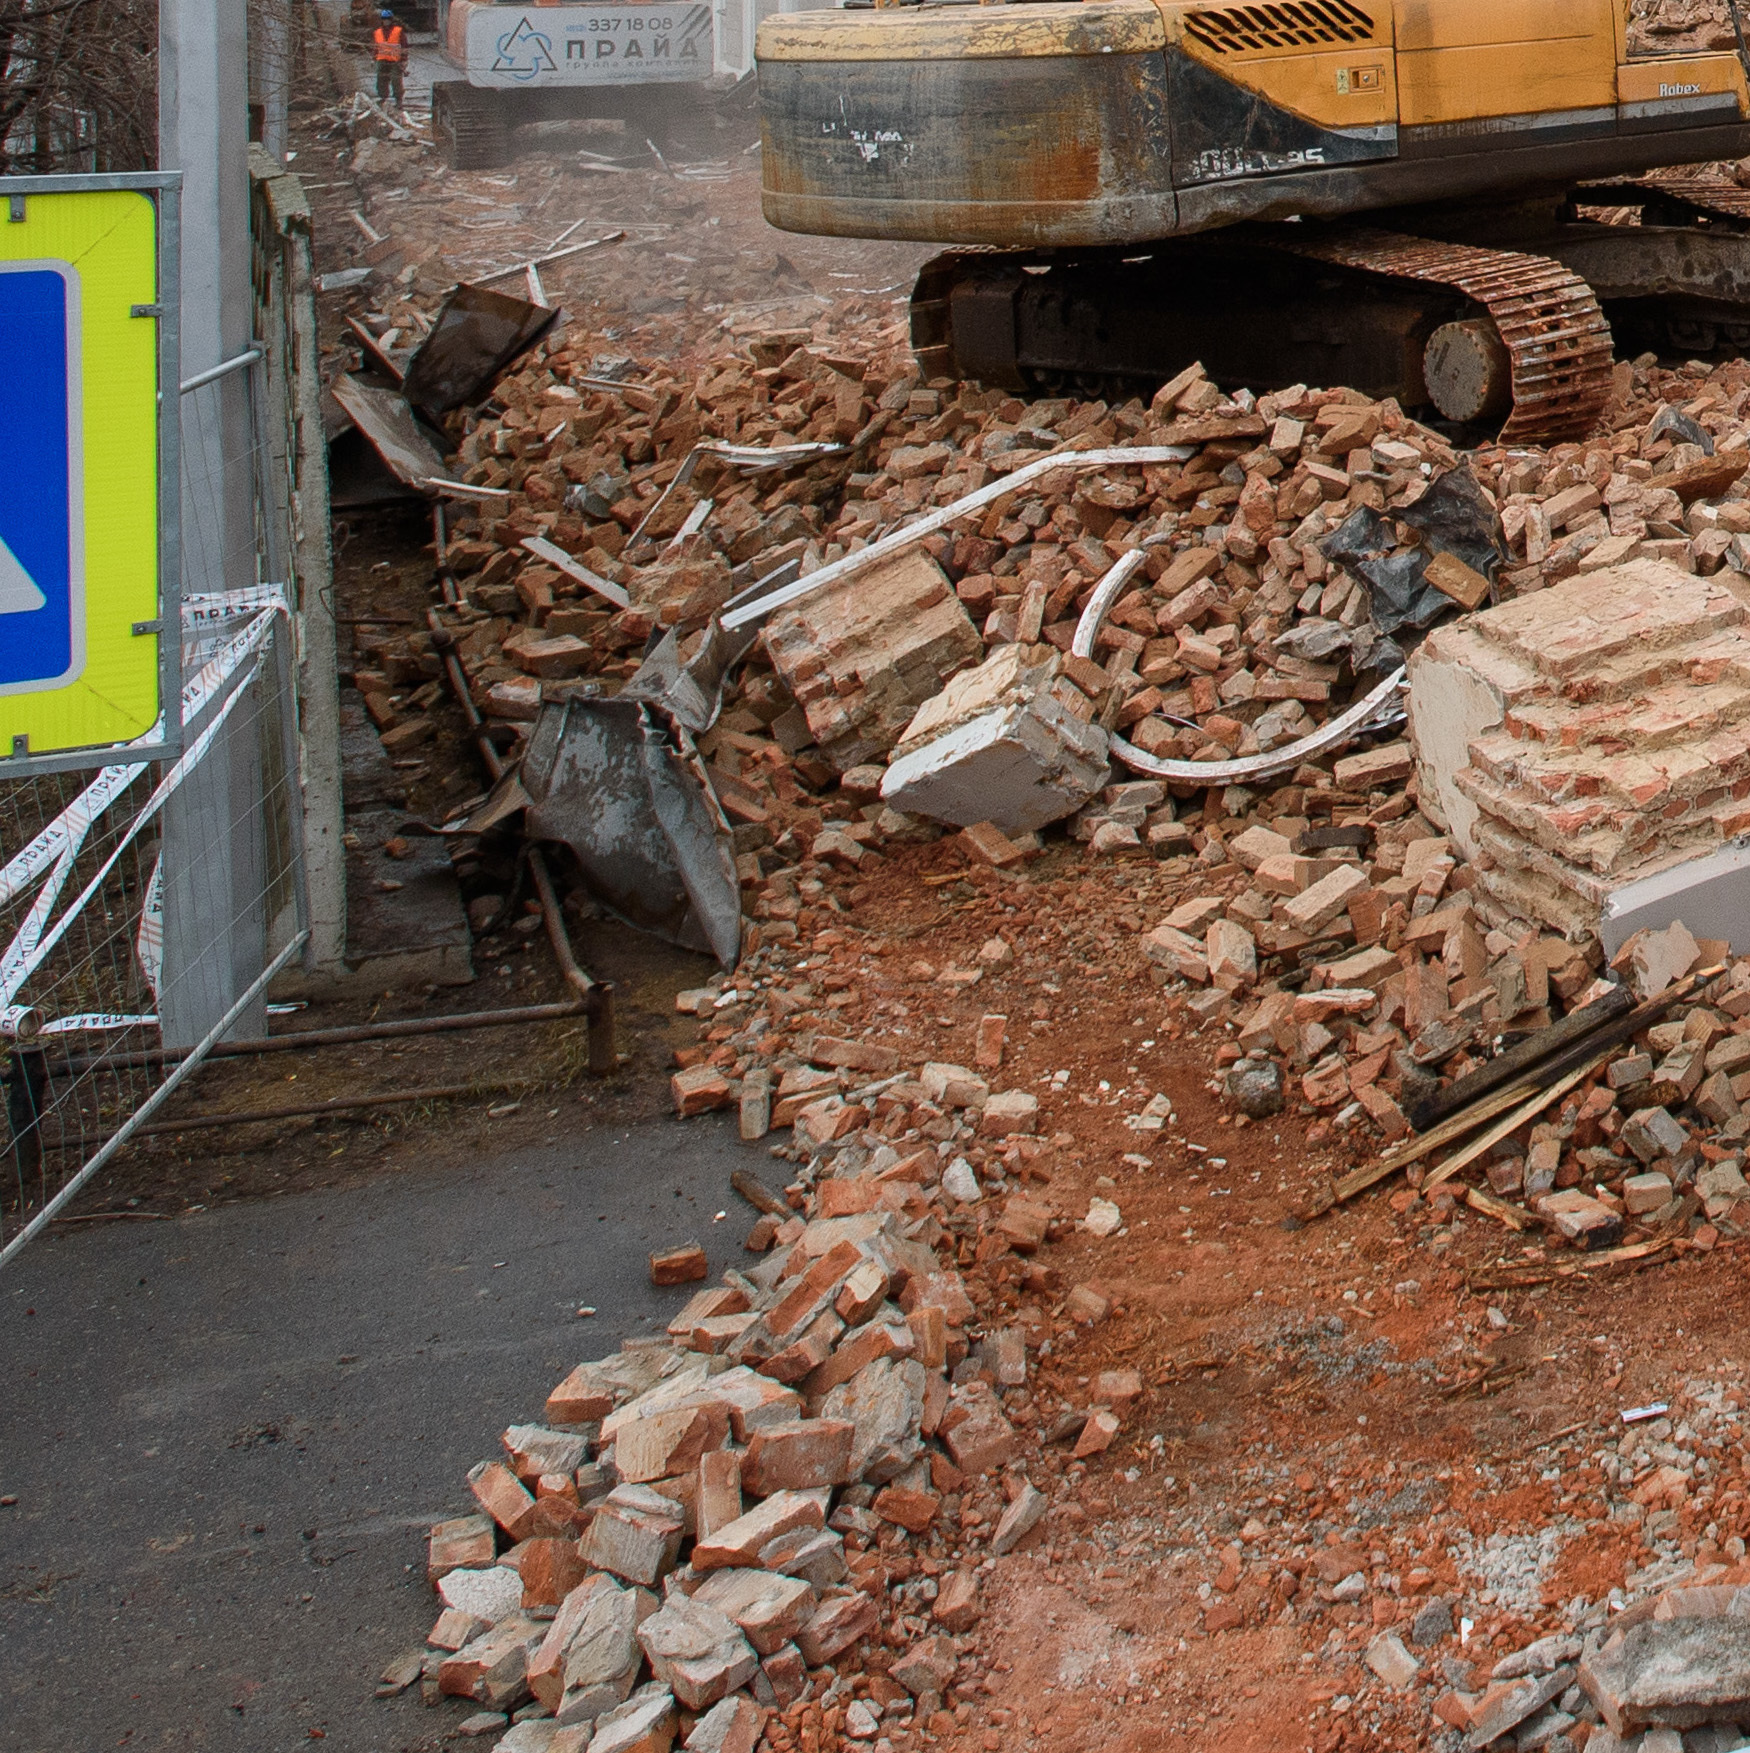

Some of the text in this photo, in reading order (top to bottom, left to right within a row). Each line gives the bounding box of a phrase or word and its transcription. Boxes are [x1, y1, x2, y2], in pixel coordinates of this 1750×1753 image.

[588, 18, 622, 32] 337
[626, 17, 644, 31] 18
[648, 17, 673, 31] 08
[566, 33, 699, 59] ПРАЙД
[1659, 82, 1700, 97] Robex
[90, 763, 129, 797] ПРАЙ
